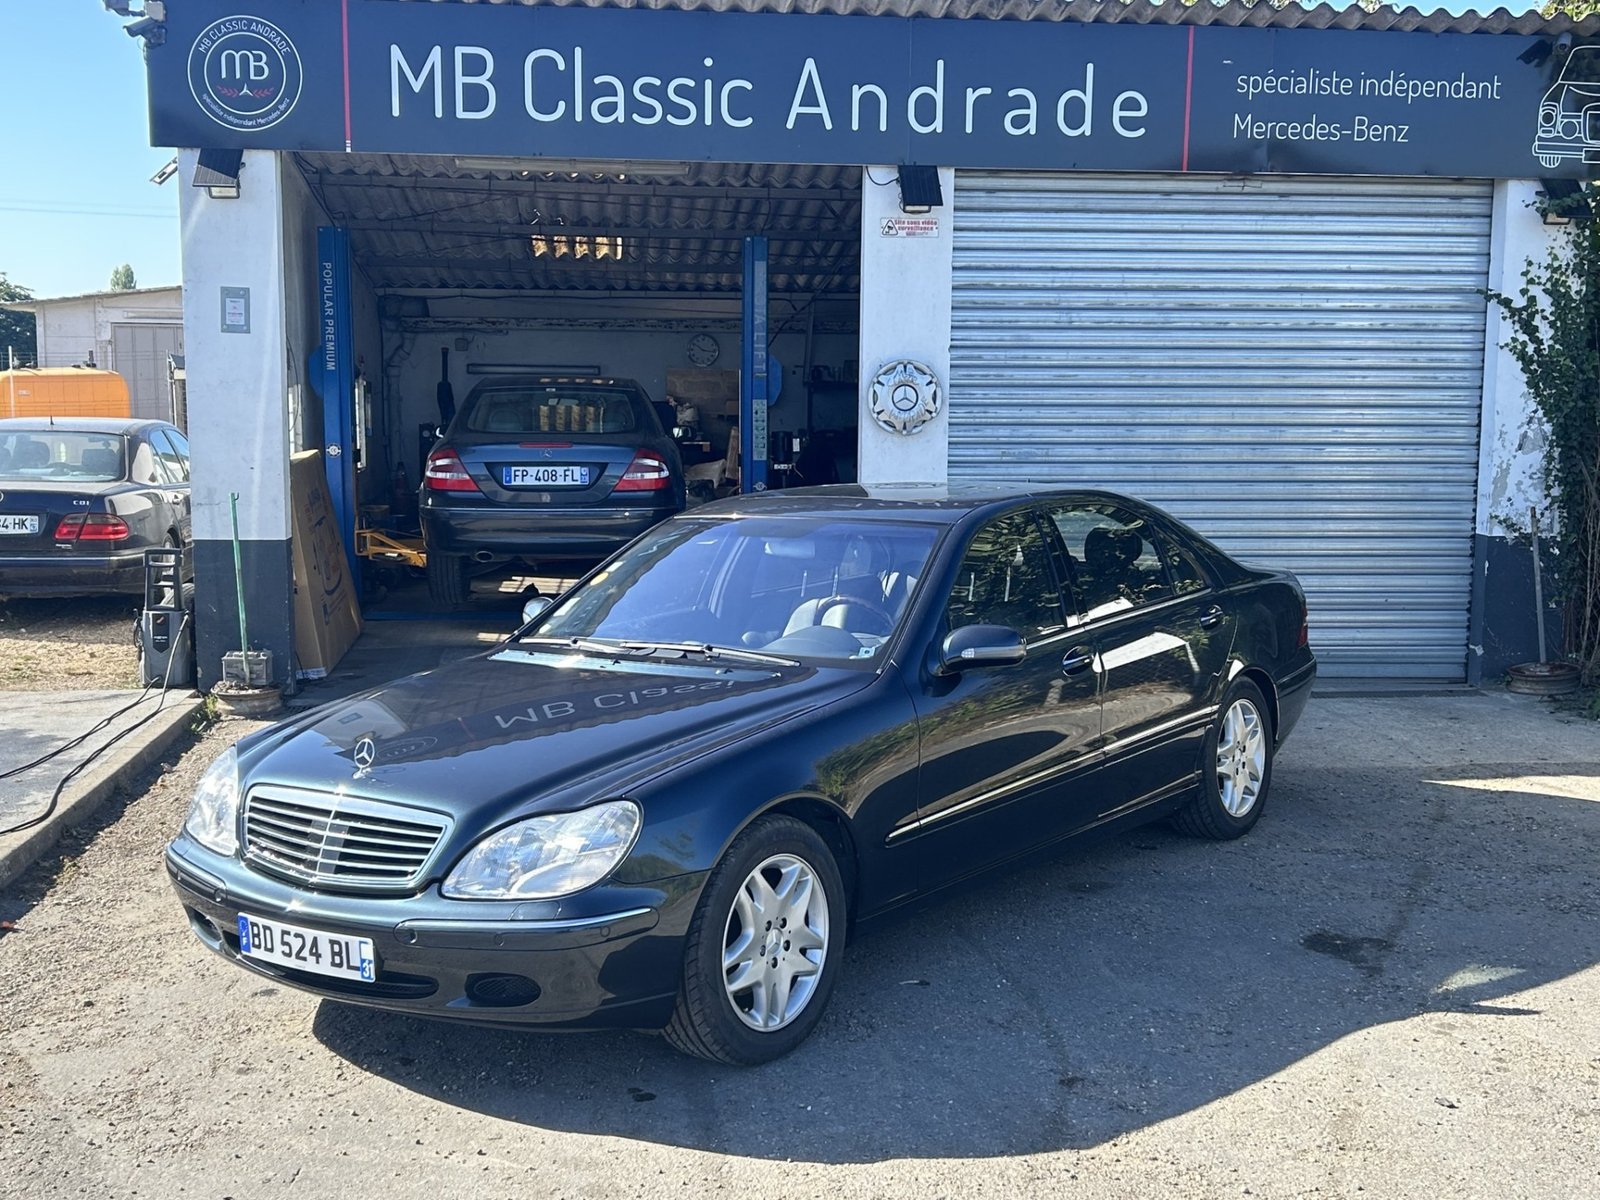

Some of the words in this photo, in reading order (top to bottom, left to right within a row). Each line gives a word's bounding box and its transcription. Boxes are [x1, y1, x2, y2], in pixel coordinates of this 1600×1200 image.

[198, 38, 212, 53] MB
[209, 20, 248, 41] CLASSIC
[250, 22, 291, 56] ANDRADE
[389, 43, 497, 119] MB
[523, 46, 754, 128] Classic
[786, 57, 1149, 138] Andrade
[1236, 67, 1353, 101] spécialiste
[1359, 71, 1502, 104] indépendant
[1233, 113, 1409, 143] Mercedes-Benz
[322, 262, 334, 316] POPULAR
[324, 319, 336, 371] PREMIUM
[513, 469, 579, 483] FP-408-FL
[250, 921, 274, 953] BD
[280, 930, 322, 965] 524
[328, 939, 361, 972] BL
